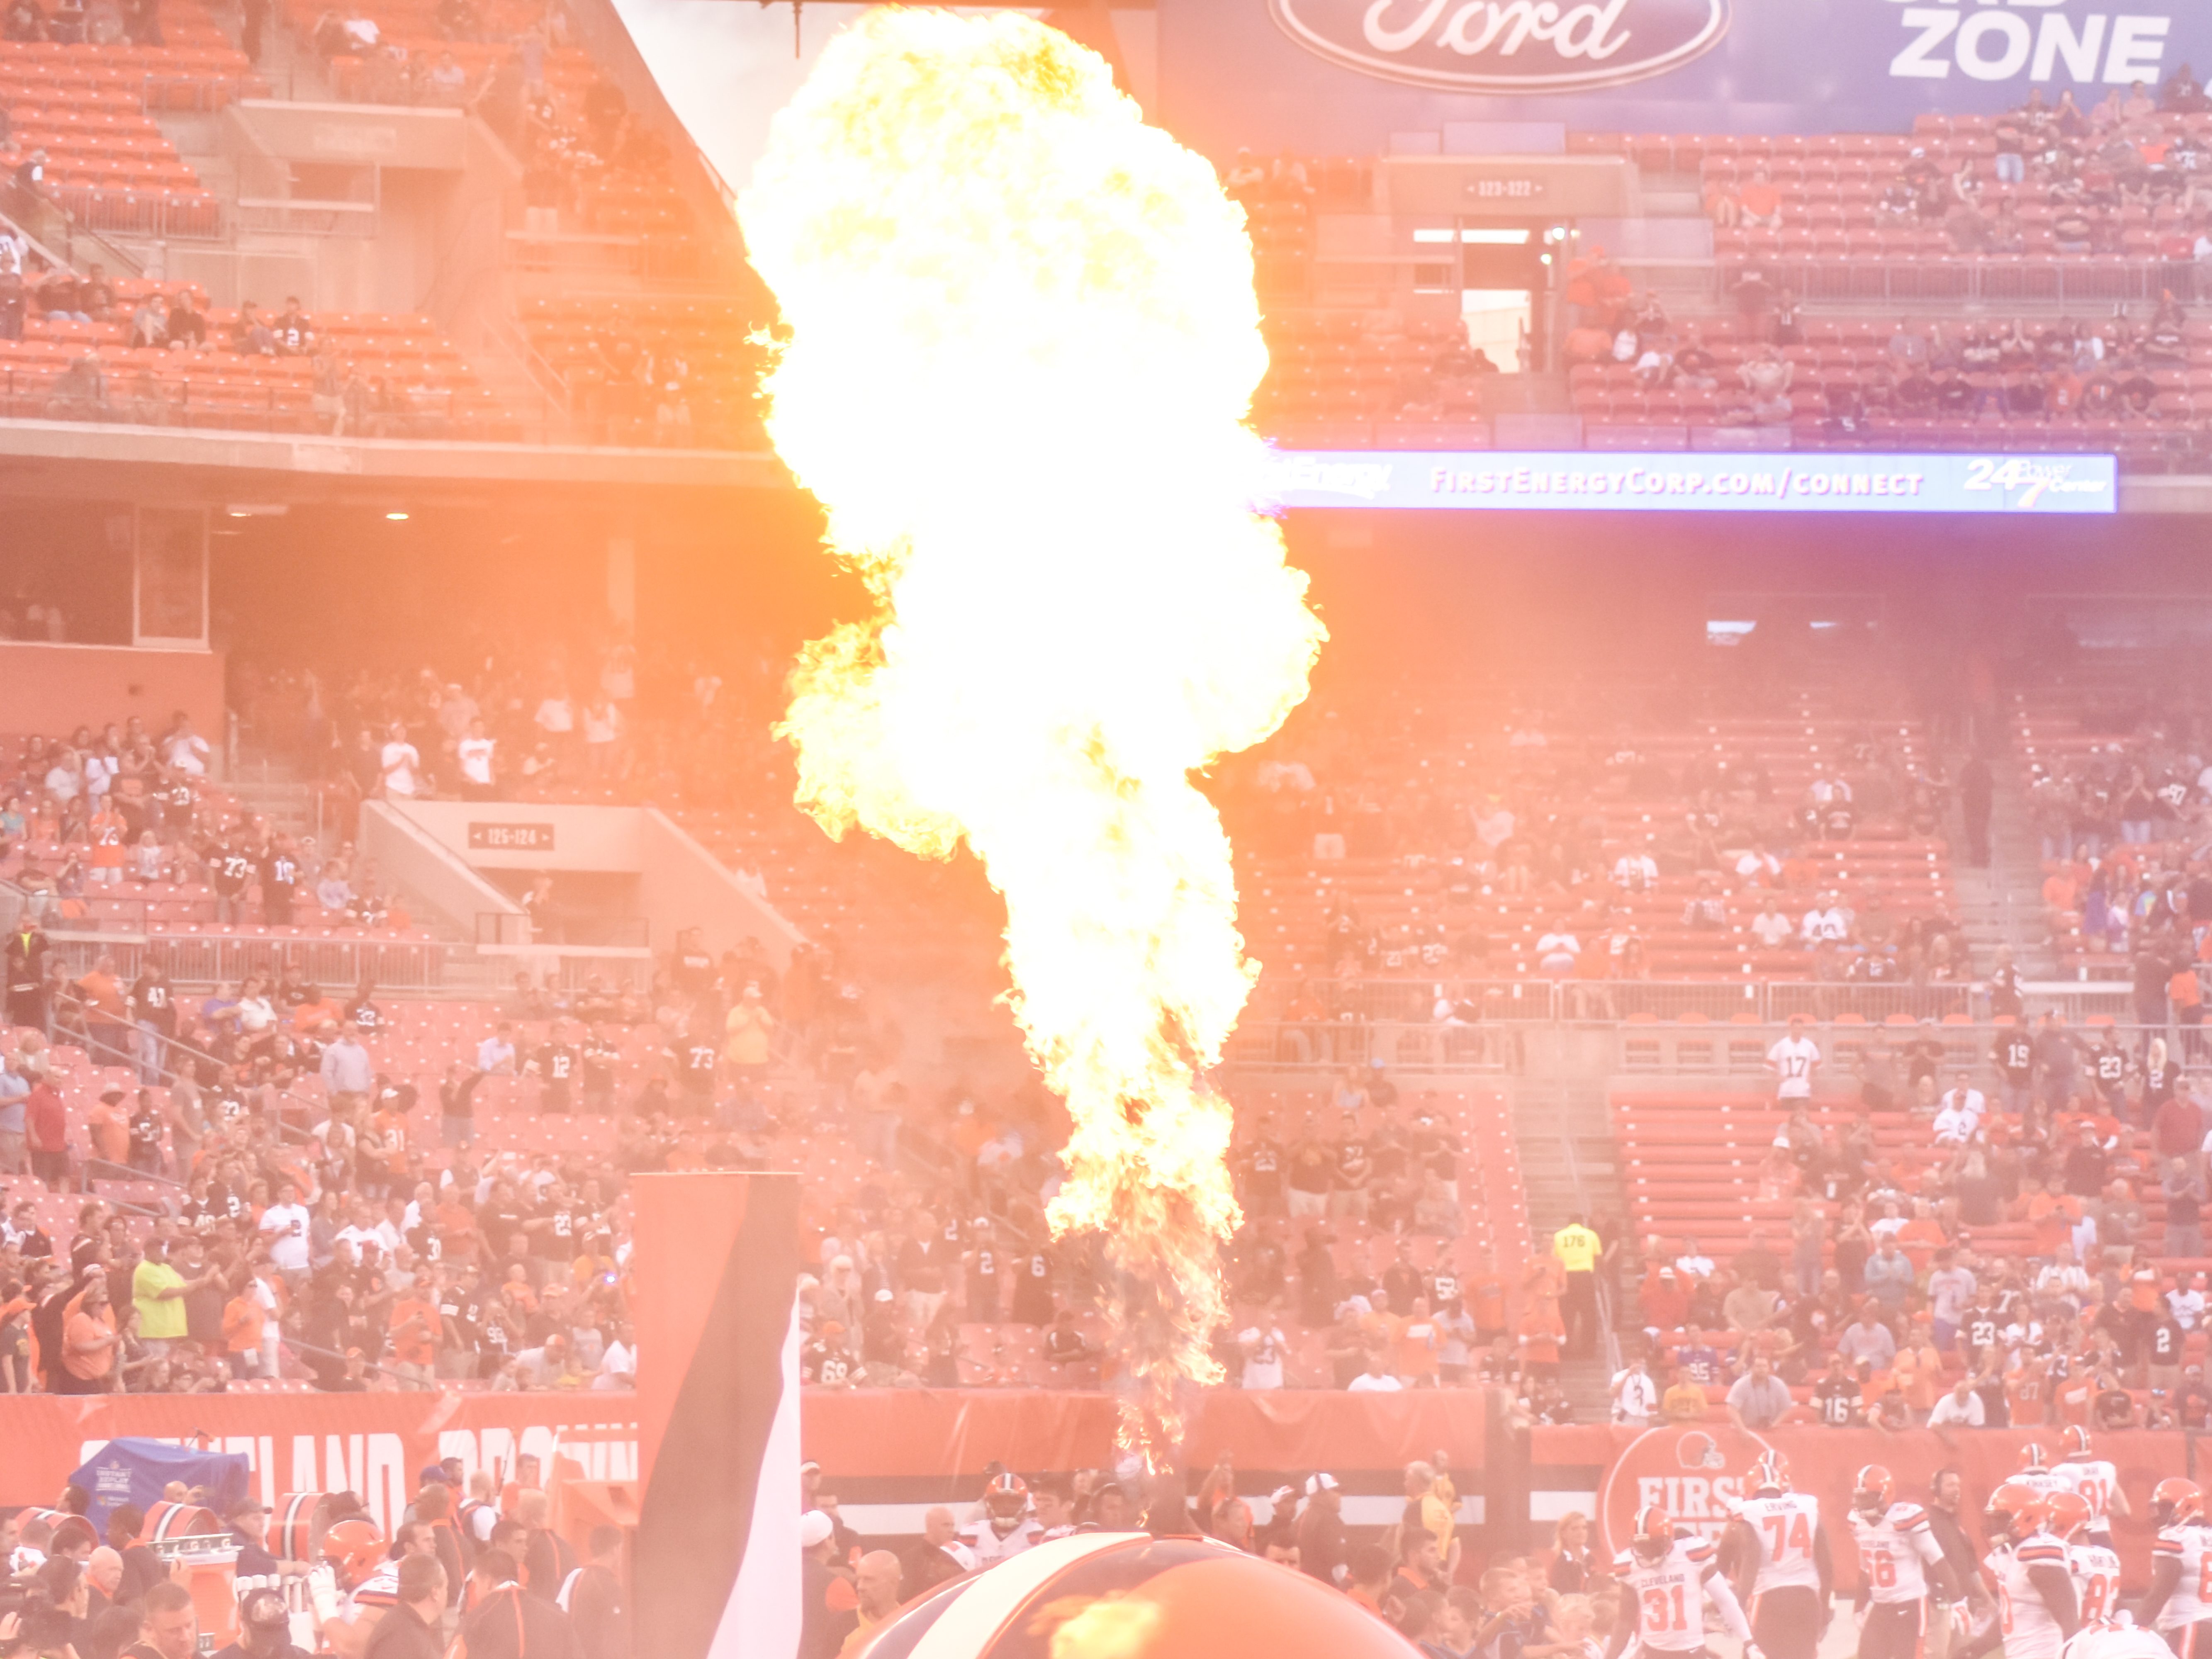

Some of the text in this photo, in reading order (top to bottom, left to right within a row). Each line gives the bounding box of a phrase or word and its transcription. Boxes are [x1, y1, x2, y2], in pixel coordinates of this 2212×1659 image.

[1889, 8, 2171, 84] ZONE
[2048, 479, 2107, 492] Center
[552, 1056, 570, 1078] 12
[689, 1047, 715, 1070] 73
[1786, 1056, 1806, 1078] 17
[2008, 1044, 2029, 1068] 19
[2099, 1056, 2122, 1079] 23
[226, 1196, 241, 1218] 2
[554, 1214, 572, 1236] 23
[980, 1251, 995, 1275] 2
[1031, 1254, 1046, 1277] 6
[1971, 1322, 1995, 1345] 23
[2156, 1327, 2171, 1353] 2
[1825, 1396, 1849, 1423] 16
[1762, 1513, 1812, 1562] 74
[1643, 1585, 1687, 1631] 31
